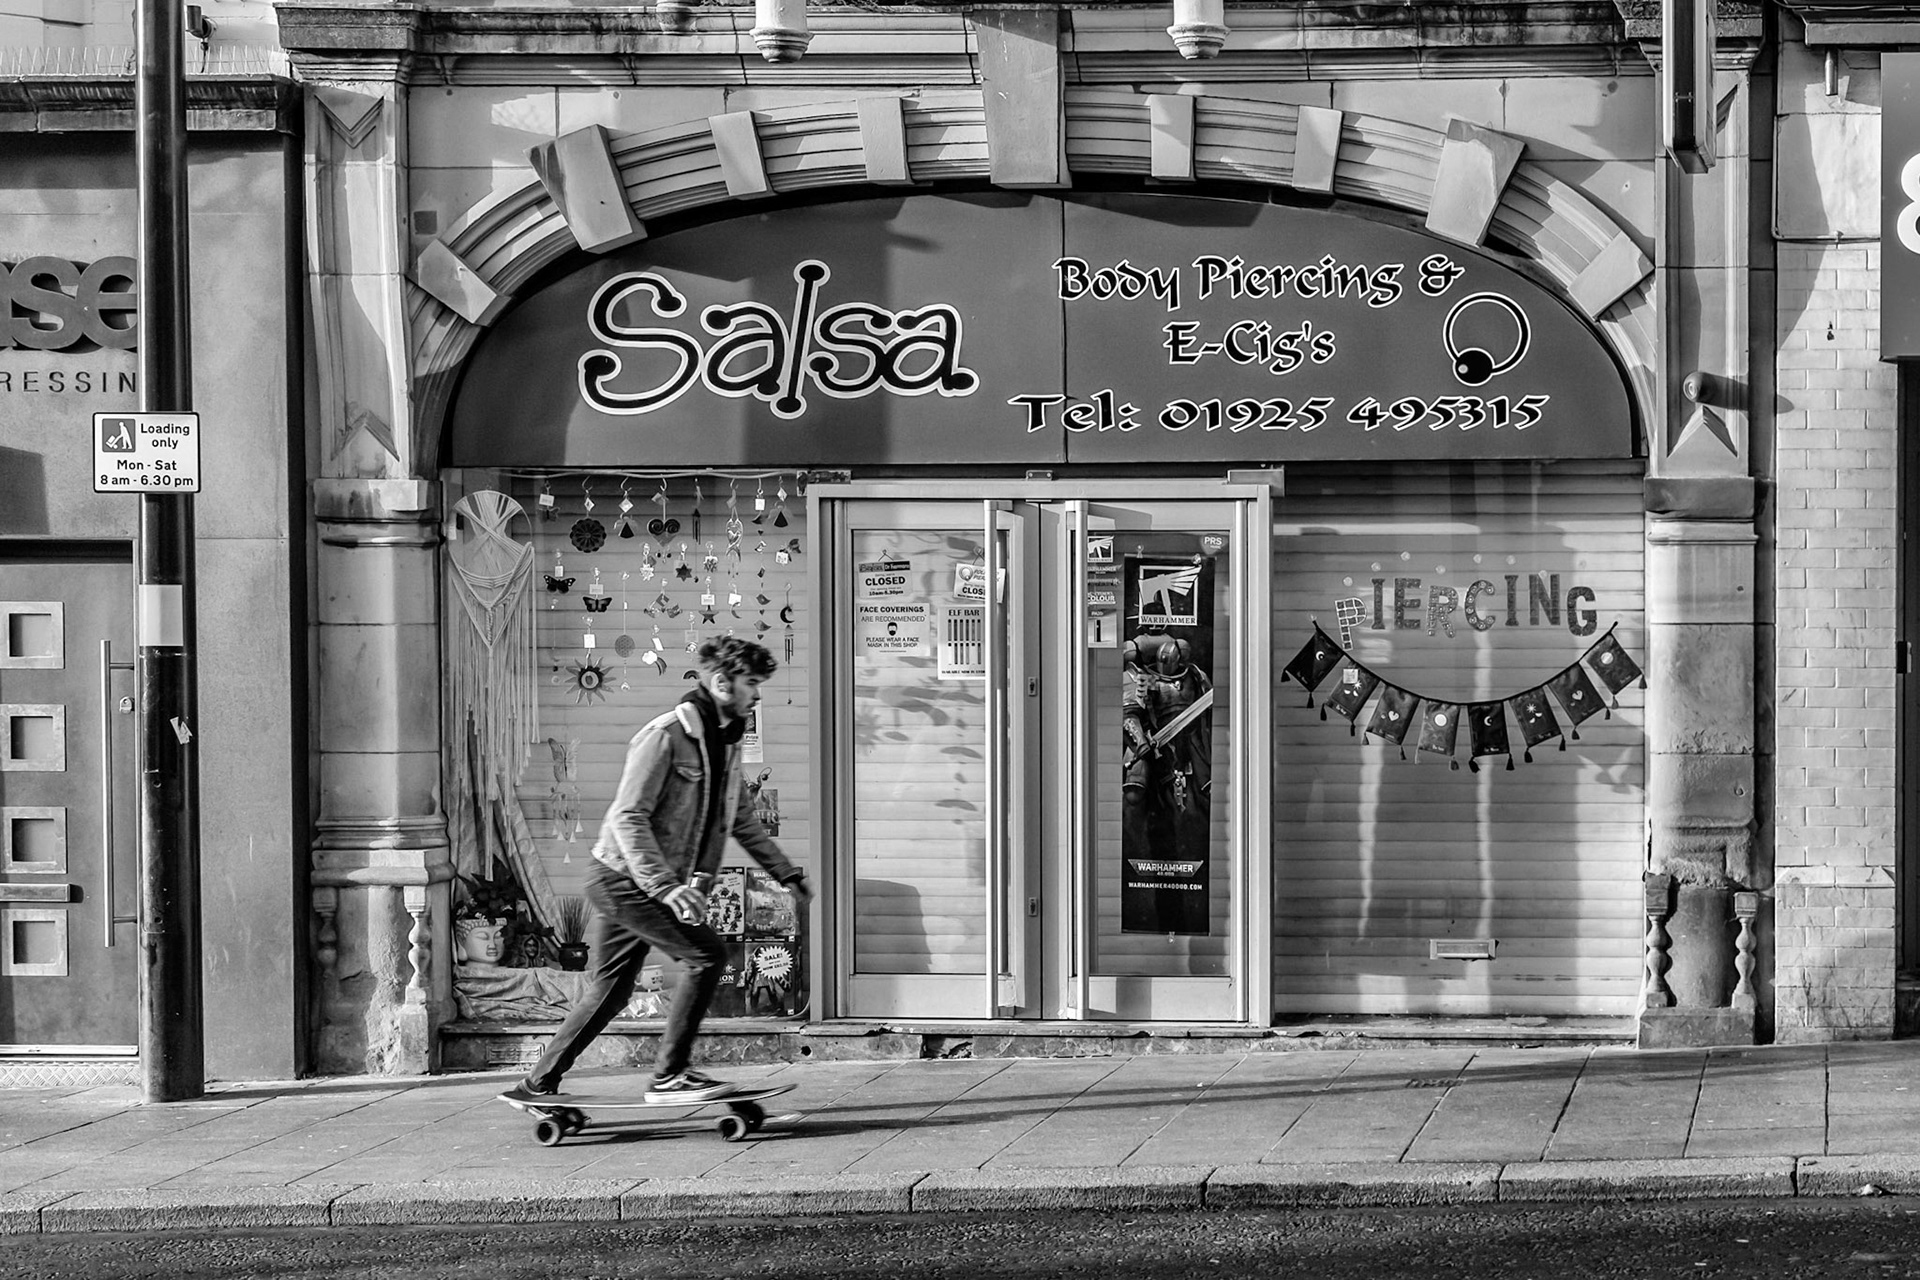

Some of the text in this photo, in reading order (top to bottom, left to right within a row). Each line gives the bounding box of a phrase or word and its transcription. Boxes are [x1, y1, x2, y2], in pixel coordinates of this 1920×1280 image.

[1051, 254, 1465, 312] Body Piercing &
[0, 256, 137, 350] se
[578, 259, 980, 420] Salsa
[1162, 320, 1336, 375] E-Cig's
[1006, 388, 1551, 433] Tel: 01925 495315
[140, 423, 190, 436] Loading
[151, 437, 179, 449] only
[117, 460, 144, 470] Mon
[154, 460, 177, 470] Sat
[100, 474, 108, 485] 8
[111, 477, 130, 485] am
[140, 474, 171, 486] 6.30
[174, 478, 193, 487] pm
[1204, 536, 1222, 545] PRS
[865, 576, 906, 586] CLOSED
[962, 586, 985, 596] CLOS
[1335, 573, 1598, 651] PIERCING
[1140, 615, 1197, 624] WARHAMMER
[1137, 862, 1194, 873] WARHAMMER
[1128, 882, 1203, 890] WARHAMMER40000.COM
[764, 952, 783, 961] SALE!
